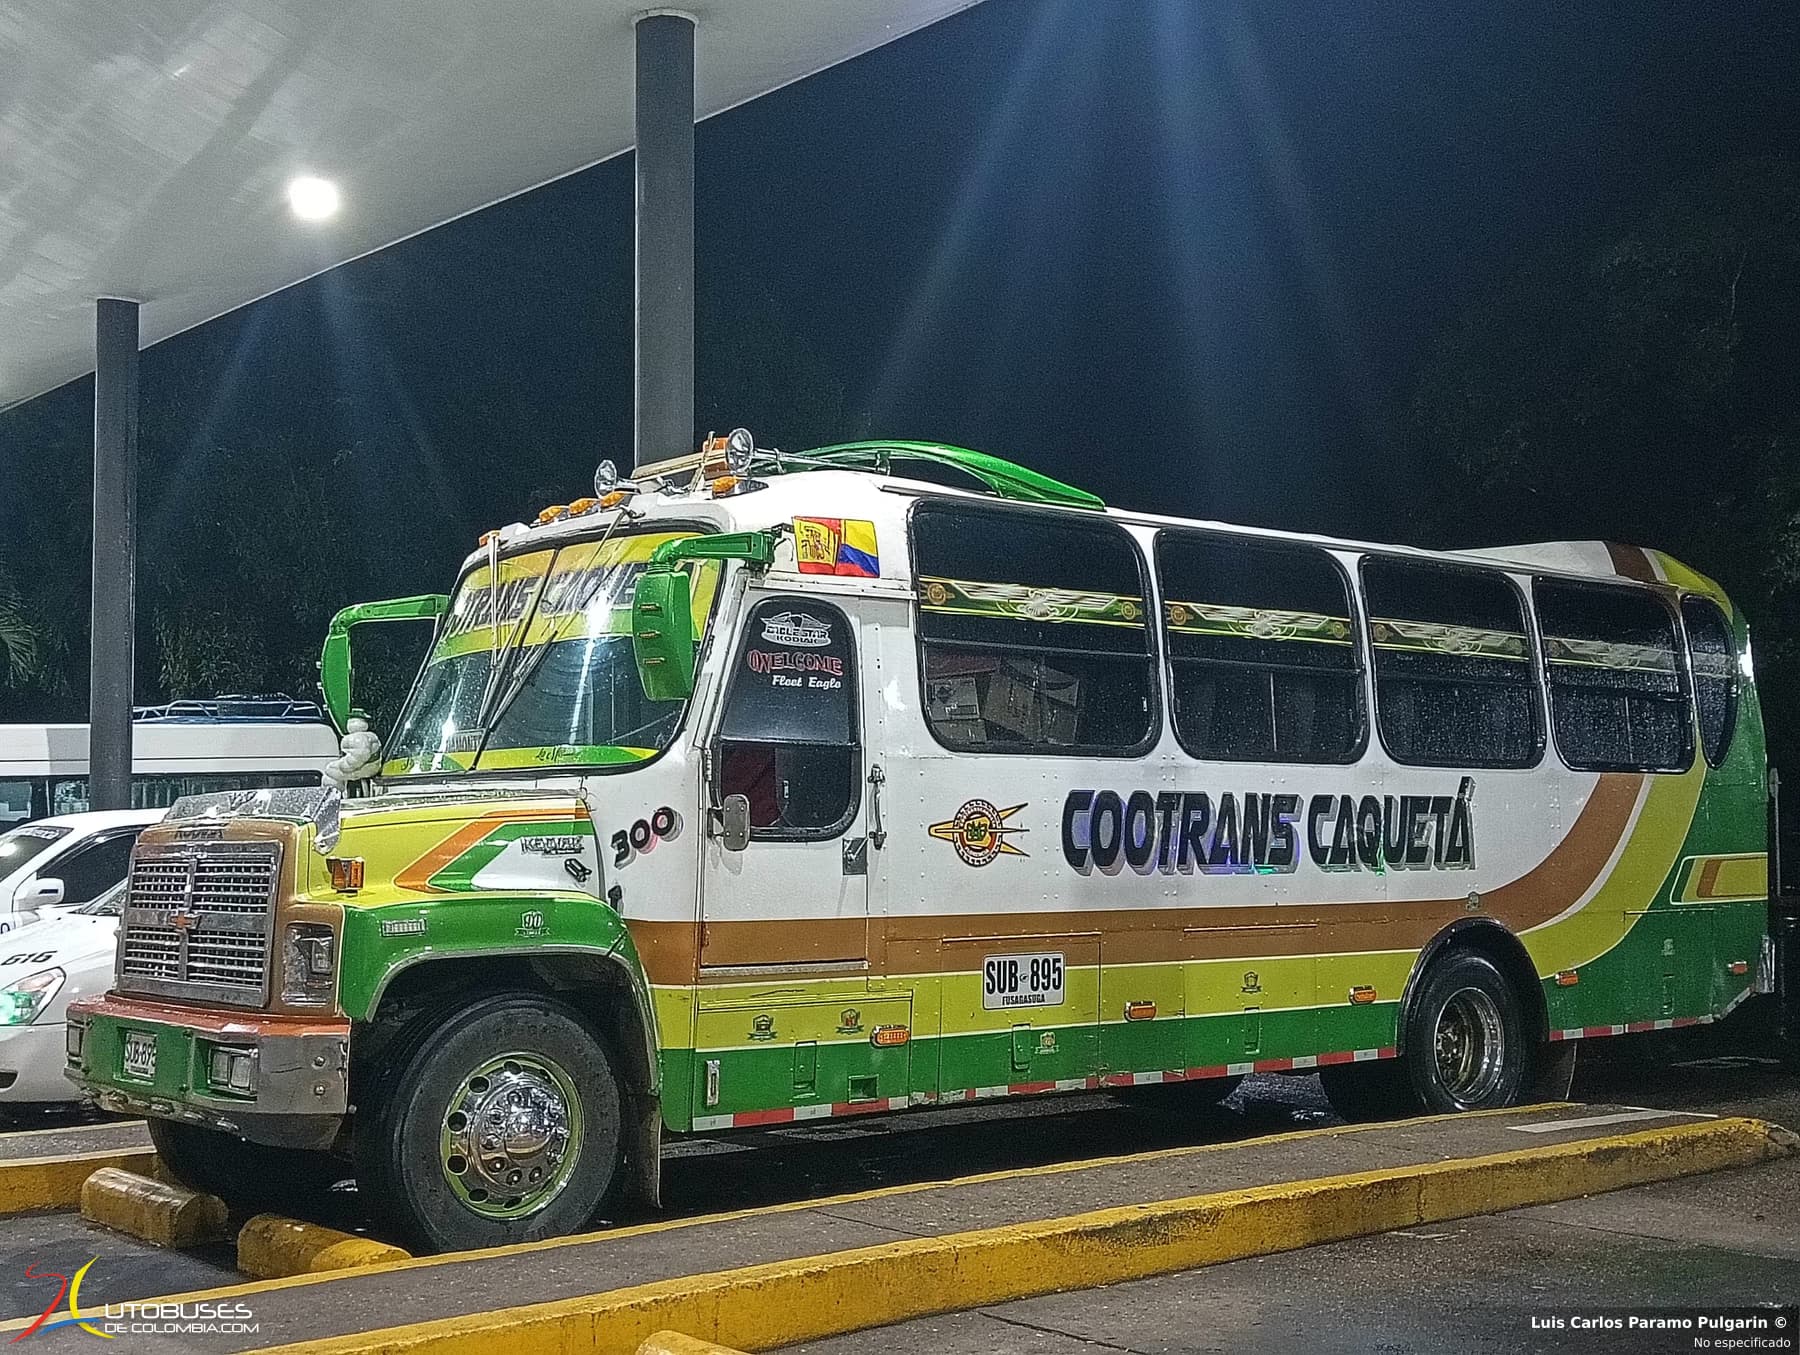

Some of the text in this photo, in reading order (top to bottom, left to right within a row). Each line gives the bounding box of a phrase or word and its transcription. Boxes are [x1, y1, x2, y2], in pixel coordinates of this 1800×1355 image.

[772, 674, 842, 690] Fleet Eagle
[610, 806, 684, 870] 300
[1061, 775, 1477, 876] COOTRANS CAQUETÁ
